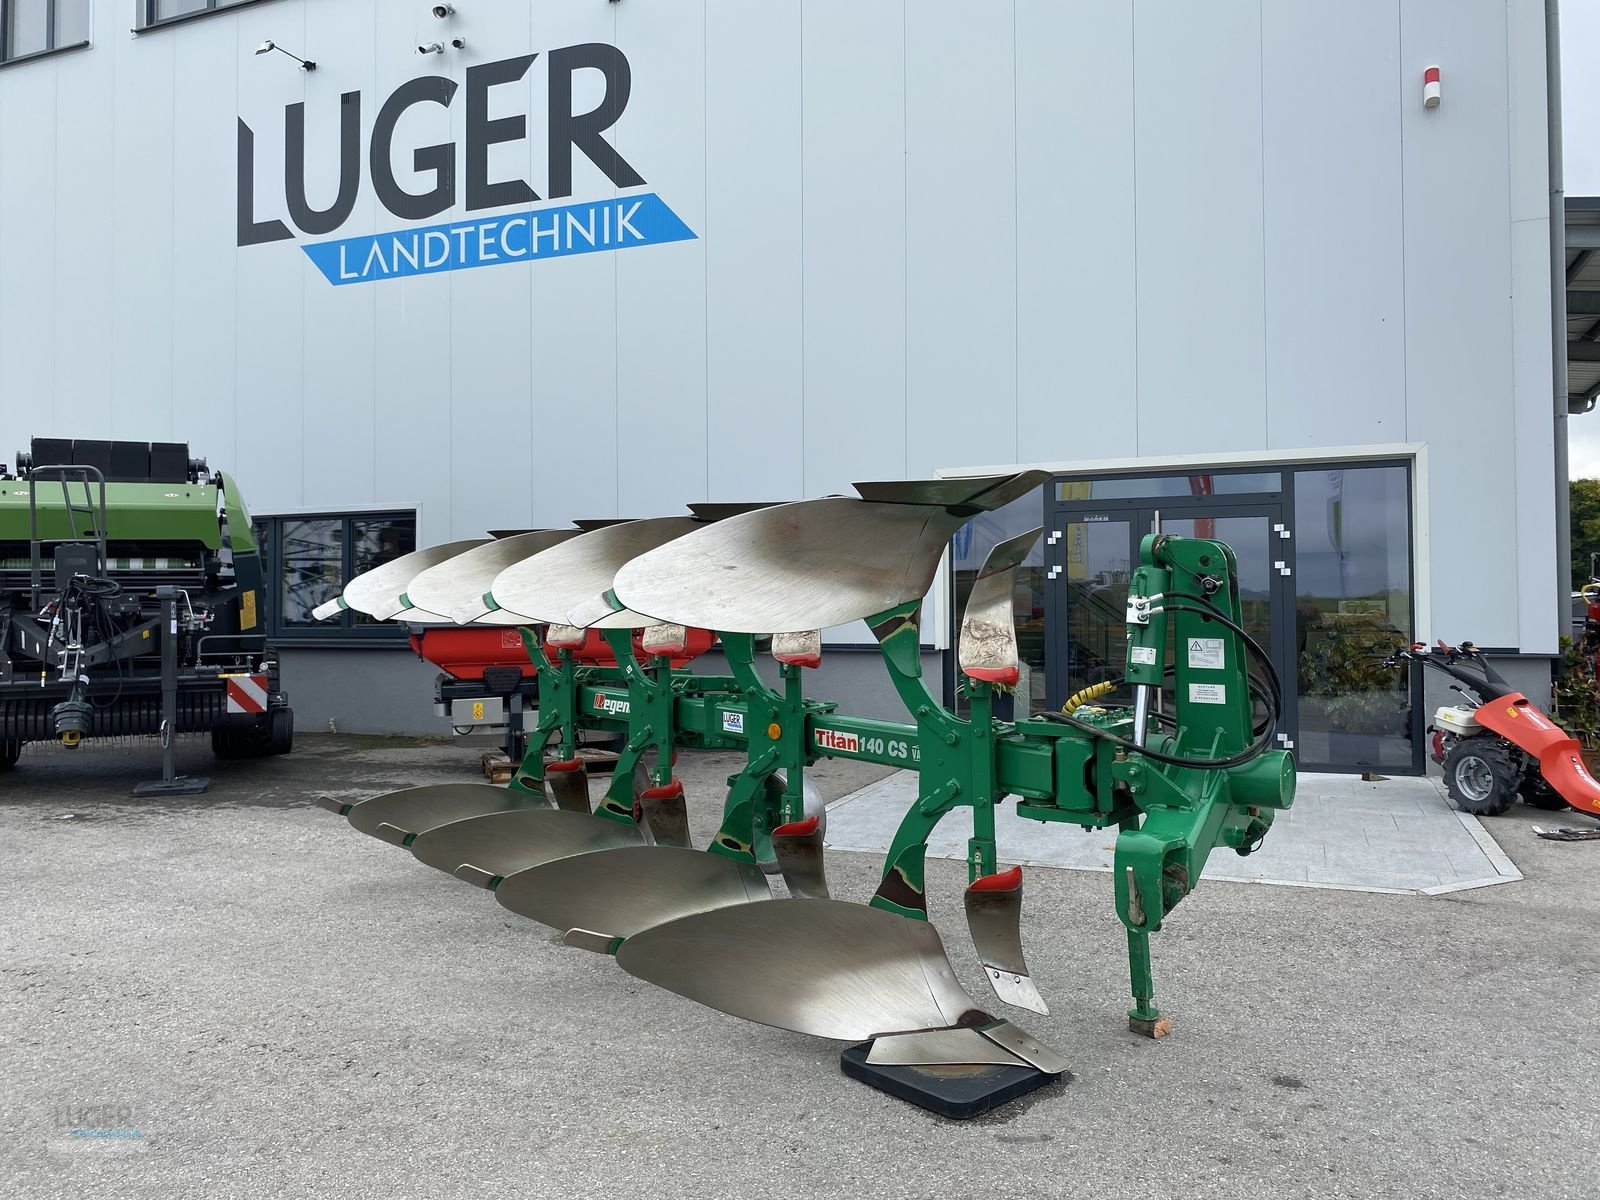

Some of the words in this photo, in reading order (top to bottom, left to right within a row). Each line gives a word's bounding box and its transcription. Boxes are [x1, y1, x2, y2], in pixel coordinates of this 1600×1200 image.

[237, 43, 648, 247] LUGER
[339, 201, 645, 280] LANDTECHNIK
[815, 730, 857, 751] Titan
[860, 737, 884, 755] 140
[888, 740, 908, 759] CS
